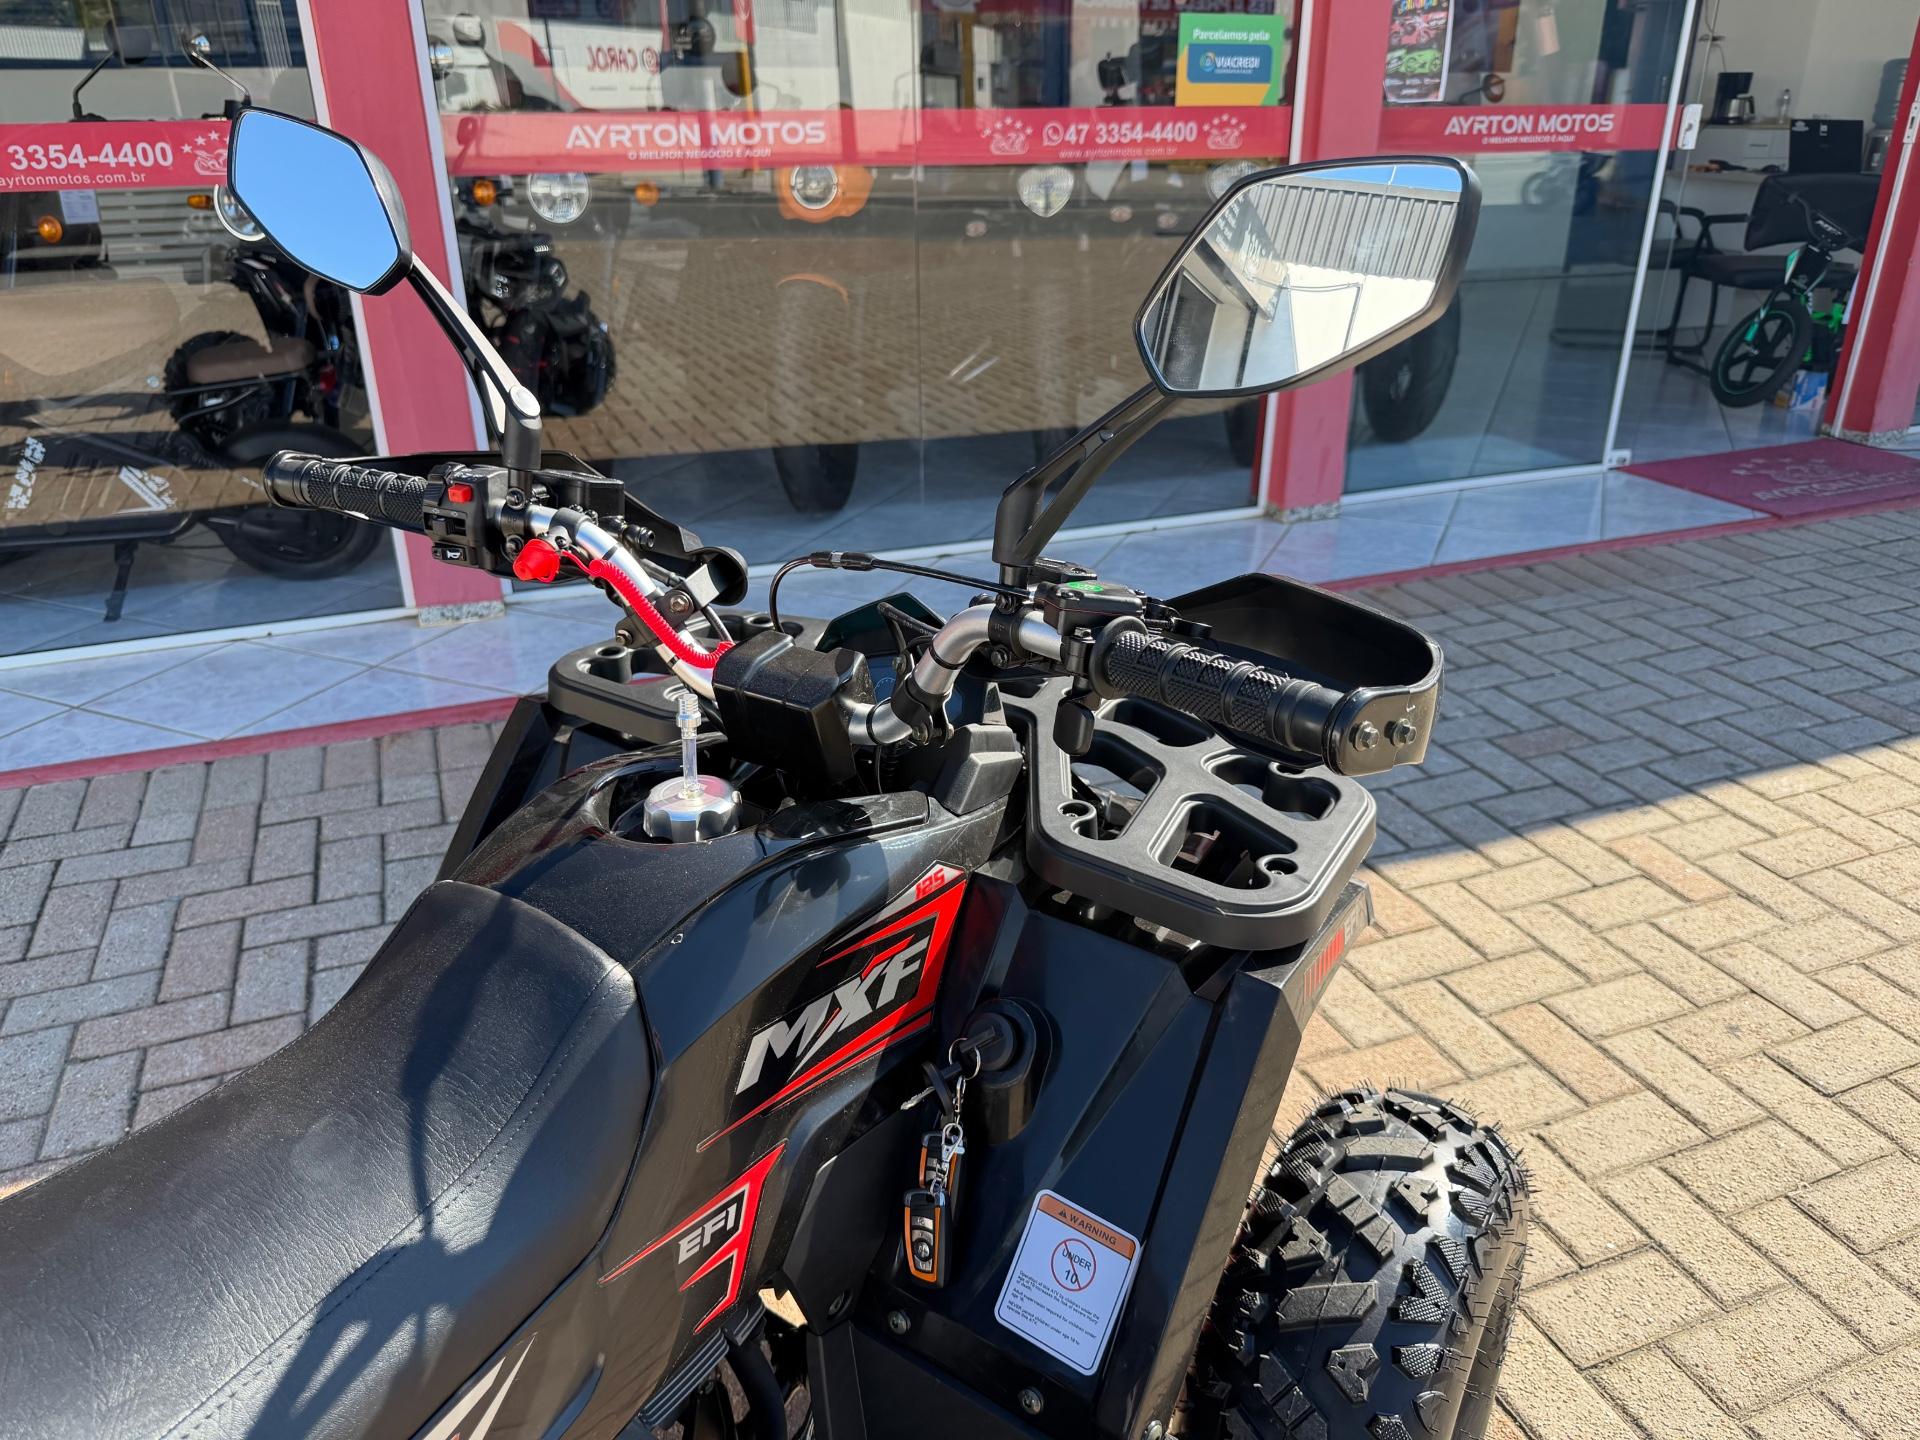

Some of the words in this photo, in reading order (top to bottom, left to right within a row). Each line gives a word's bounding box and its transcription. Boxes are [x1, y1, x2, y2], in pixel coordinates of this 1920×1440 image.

[565, 123, 700, 149] AYRTON
[710, 121, 827, 147] MOTOS
[1063, 124, 1090, 145] 47
[1095, 120, 1199, 145] 3354-4400
[1445, 114, 1534, 136] AYRTON
[1538, 113, 1616, 134] MOTOS
[7, 142, 174, 170] 3354-4400
[915, 867, 946, 900] 125
[735, 934, 931, 1096] MXF
[678, 1203, 738, 1265] EFI
[1070, 1214, 1117, 1246] WARNING
[1061, 1248, 1092, 1271] UNDER
[1064, 1269, 1078, 1285] 10
